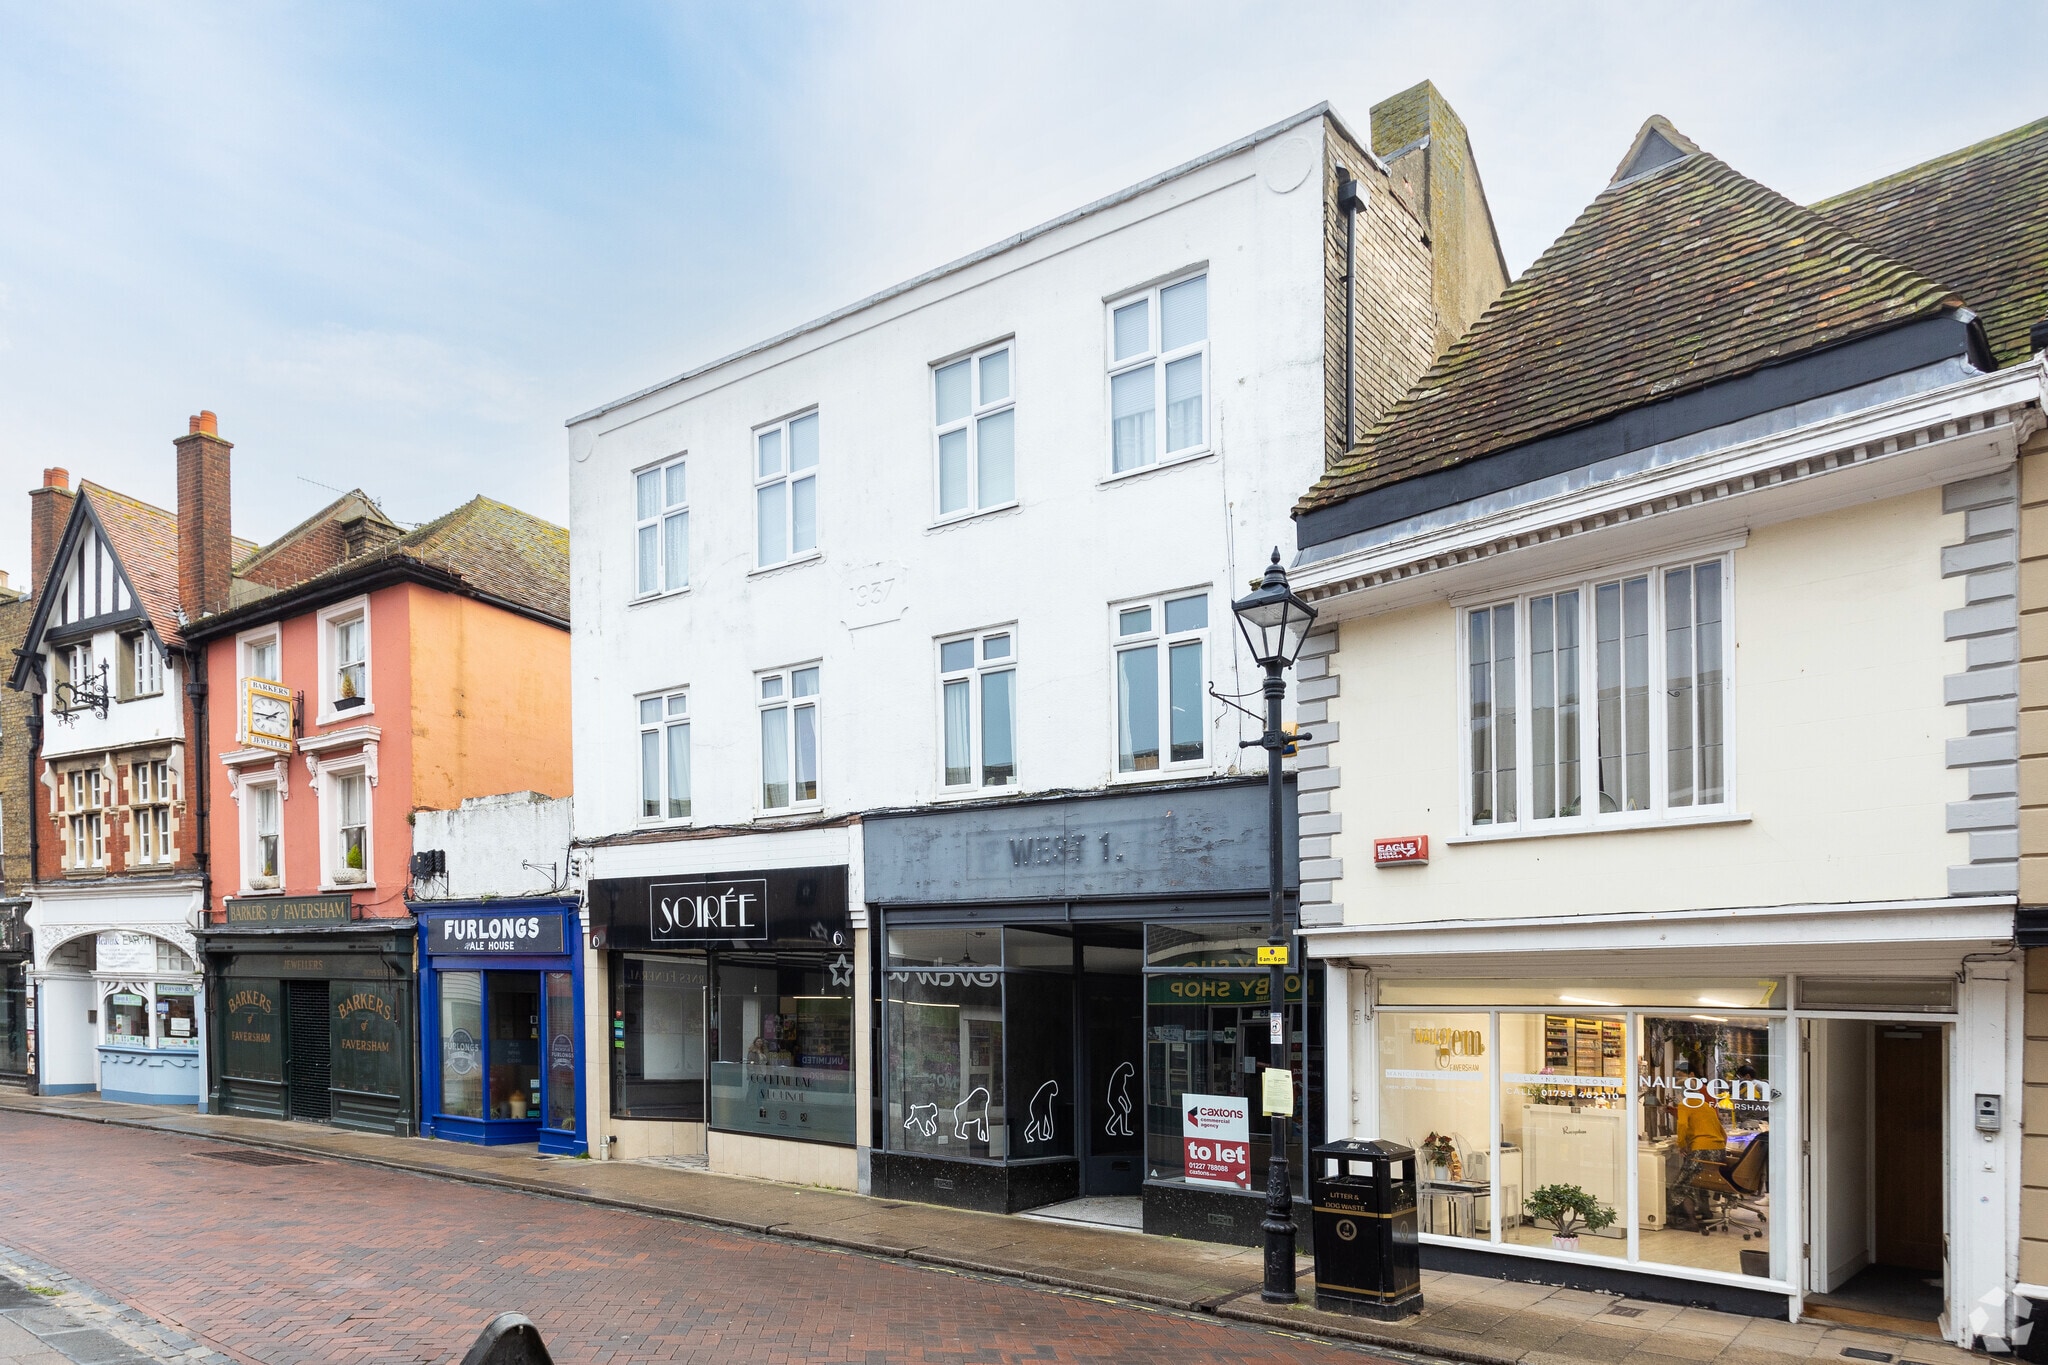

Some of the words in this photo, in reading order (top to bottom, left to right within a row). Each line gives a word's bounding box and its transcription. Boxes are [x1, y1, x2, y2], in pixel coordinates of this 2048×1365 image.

[252, 682, 288, 696] BARKERS
[253, 737, 288, 749] JEWELLER
[1009, 833, 1085, 867] WEST
[1377, 842, 1414, 852] EAGLE
[230, 905, 267, 921] BARKERS
[271, 905, 281, 920] of
[284, 901, 345, 919] FAVERSHAM
[658, 887, 758, 934] SOIRÉE
[444, 917, 540, 940] FURLONGS
[122, 934, 152, 945] EARTH
[470, 941, 485, 950] ALE
[488, 941, 515, 950] HOUSE
[283, 959, 323, 971] JEWELLERS
[1758, 981, 1778, 1004] 7
[228, 990, 272, 1014] BARKERS
[337, 993, 392, 1021] BARKERS
[360, 1020, 369, 1032] of
[231, 1031, 271, 1043] FAVERSHAM
[341, 1039, 389, 1052] FAVERSHAM
[444, 1042, 479, 1052] FURLONGS
[1563, 1077, 1614, 1085] WELCOME
[1541, 1089, 1574, 1098] 01795
[1578, 1091, 1620, 1100] 462310
[1708, 1101, 1769, 1111] FARSHAM
[1200, 1107, 1244, 1119] caxtons
[1187, 1141, 1212, 1160] to
[1215, 1143, 1246, 1164] let
[1188, 1162, 1206, 1170] 01227
[1341, 1203, 1365, 1212] WASTE
